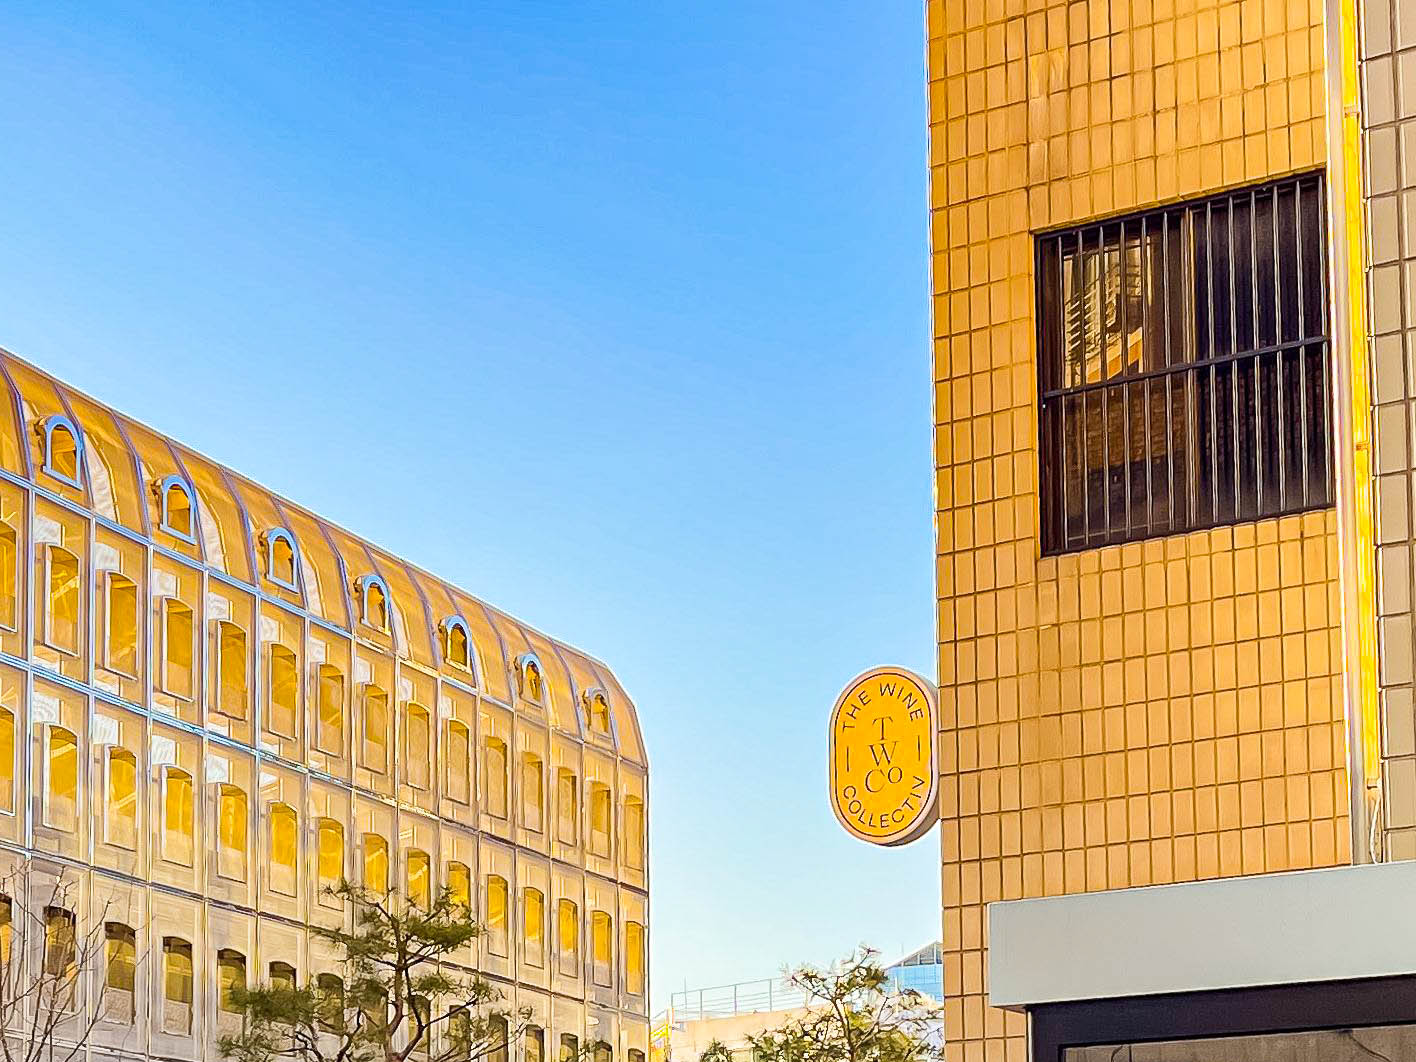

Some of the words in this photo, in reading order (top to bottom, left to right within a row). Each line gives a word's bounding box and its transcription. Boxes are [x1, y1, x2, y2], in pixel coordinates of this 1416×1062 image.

[842, 690, 872, 733] THE
[879, 682, 924, 722] WINE
[872, 716, 893, 741] T
[867, 741, 900, 767] W
[843, 775, 925, 829] COLLECTIV
